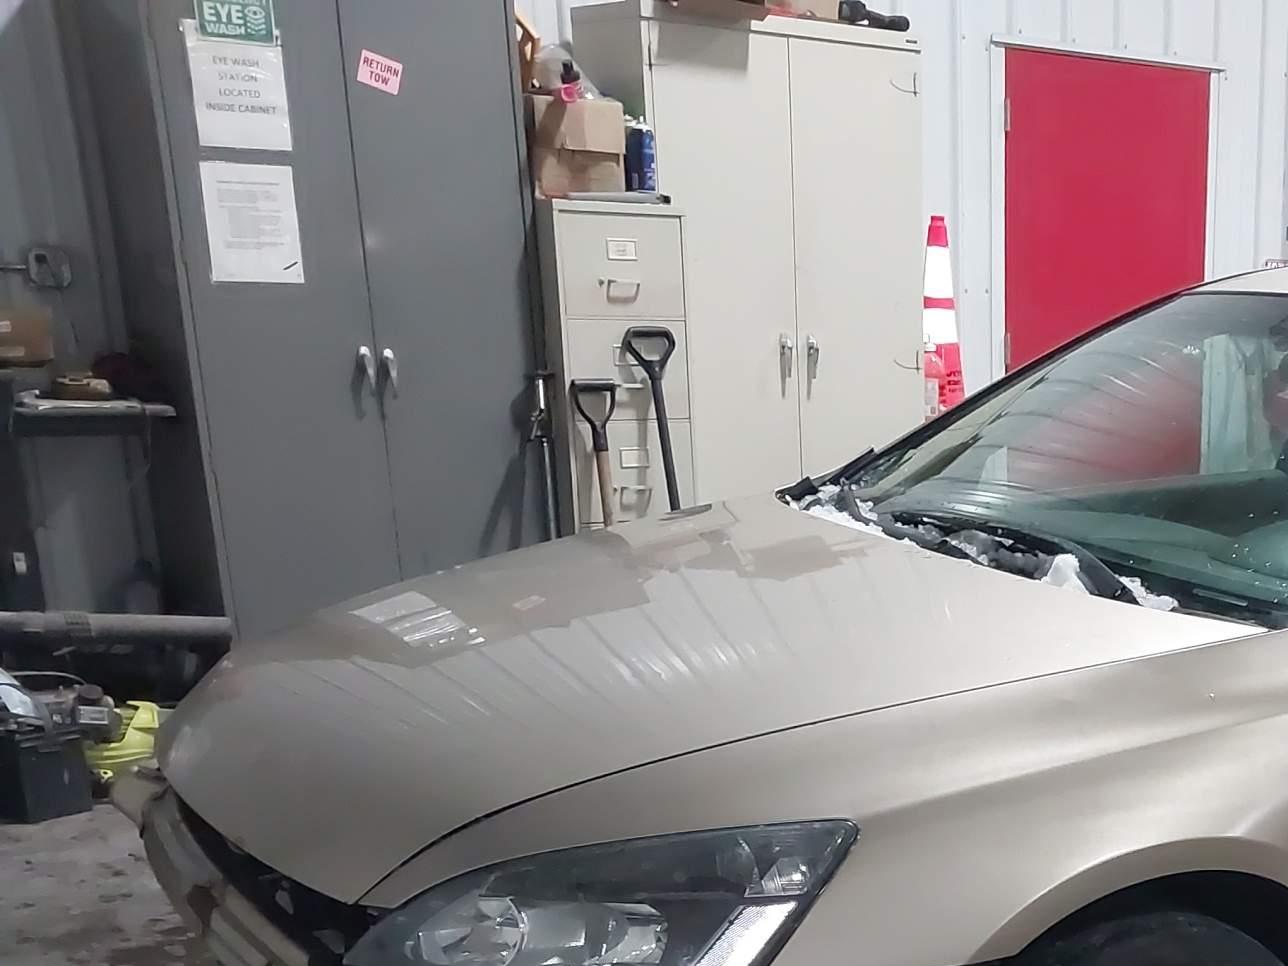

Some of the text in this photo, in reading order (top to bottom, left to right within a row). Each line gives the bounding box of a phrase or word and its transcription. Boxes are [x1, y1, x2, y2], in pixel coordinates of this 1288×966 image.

[203, 1, 245, 24] EYE
[204, 22, 245, 35] WASH
[212, 55, 260, 68] EYE WASH
[363, 56, 400, 78] RETURN
[218, 72, 258, 82] STATION
[369, 70, 390, 86] TOW
[219, 87, 261, 98] LOCATED
[205, 102, 276, 115] INSIDE CABINET
